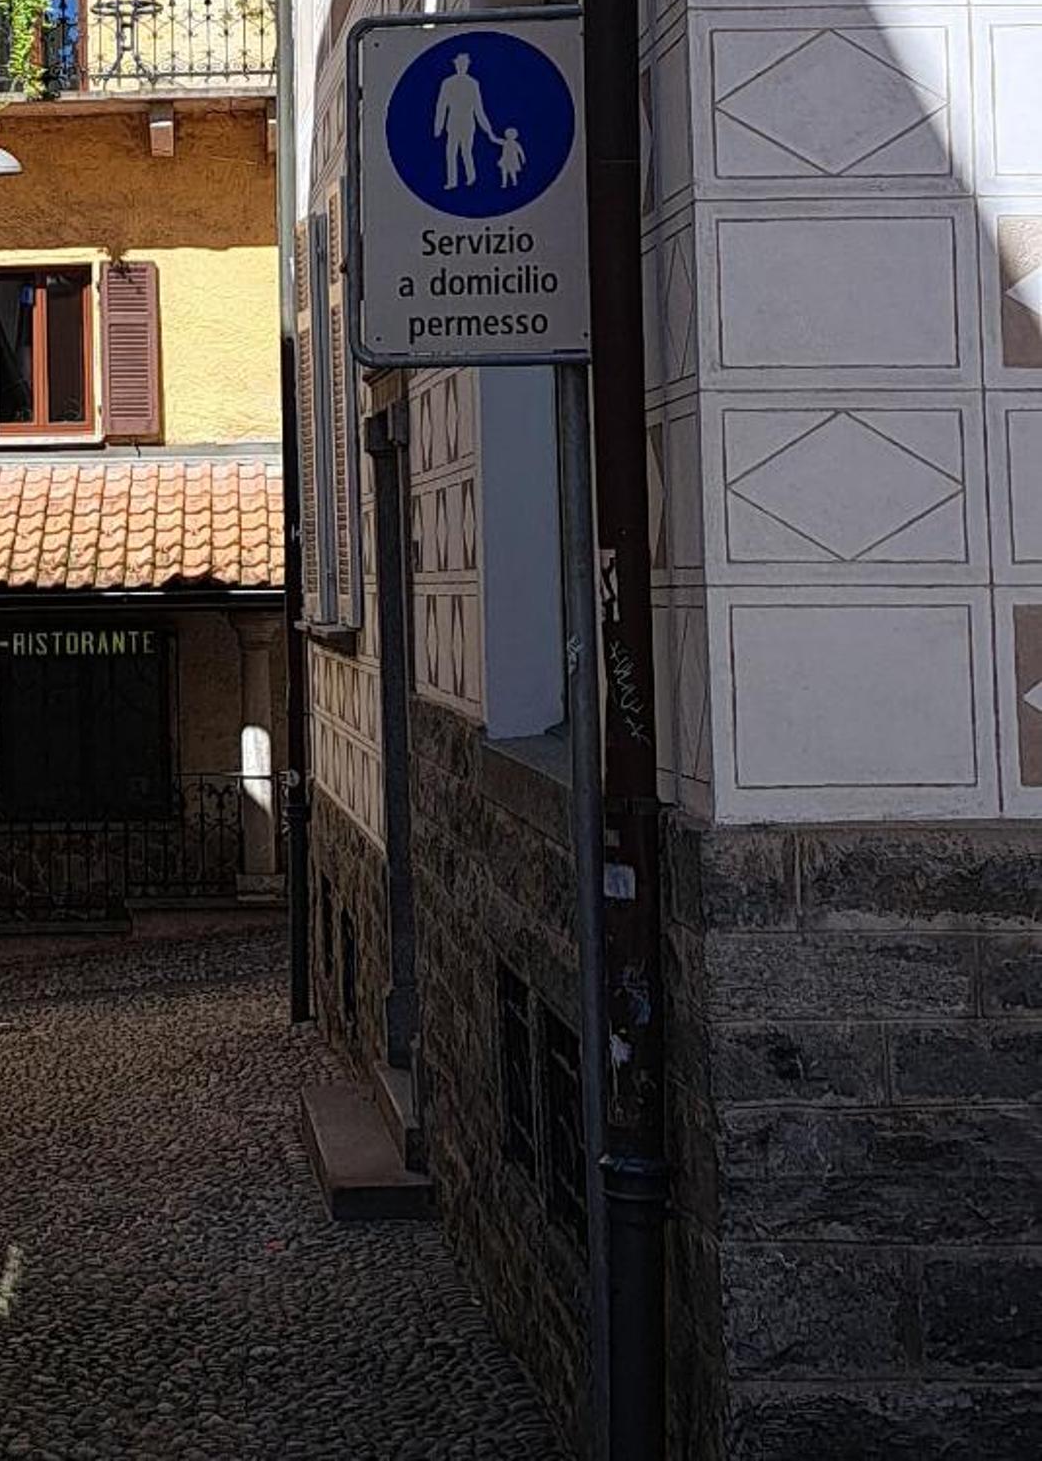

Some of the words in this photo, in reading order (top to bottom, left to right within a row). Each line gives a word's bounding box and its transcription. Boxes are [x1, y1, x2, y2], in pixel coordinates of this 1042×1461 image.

[421, 227, 535, 256] Servizio
[398, 276, 415, 298] a
[430, 266, 559, 297] domicilio
[408, 313, 549, 345] permesso
